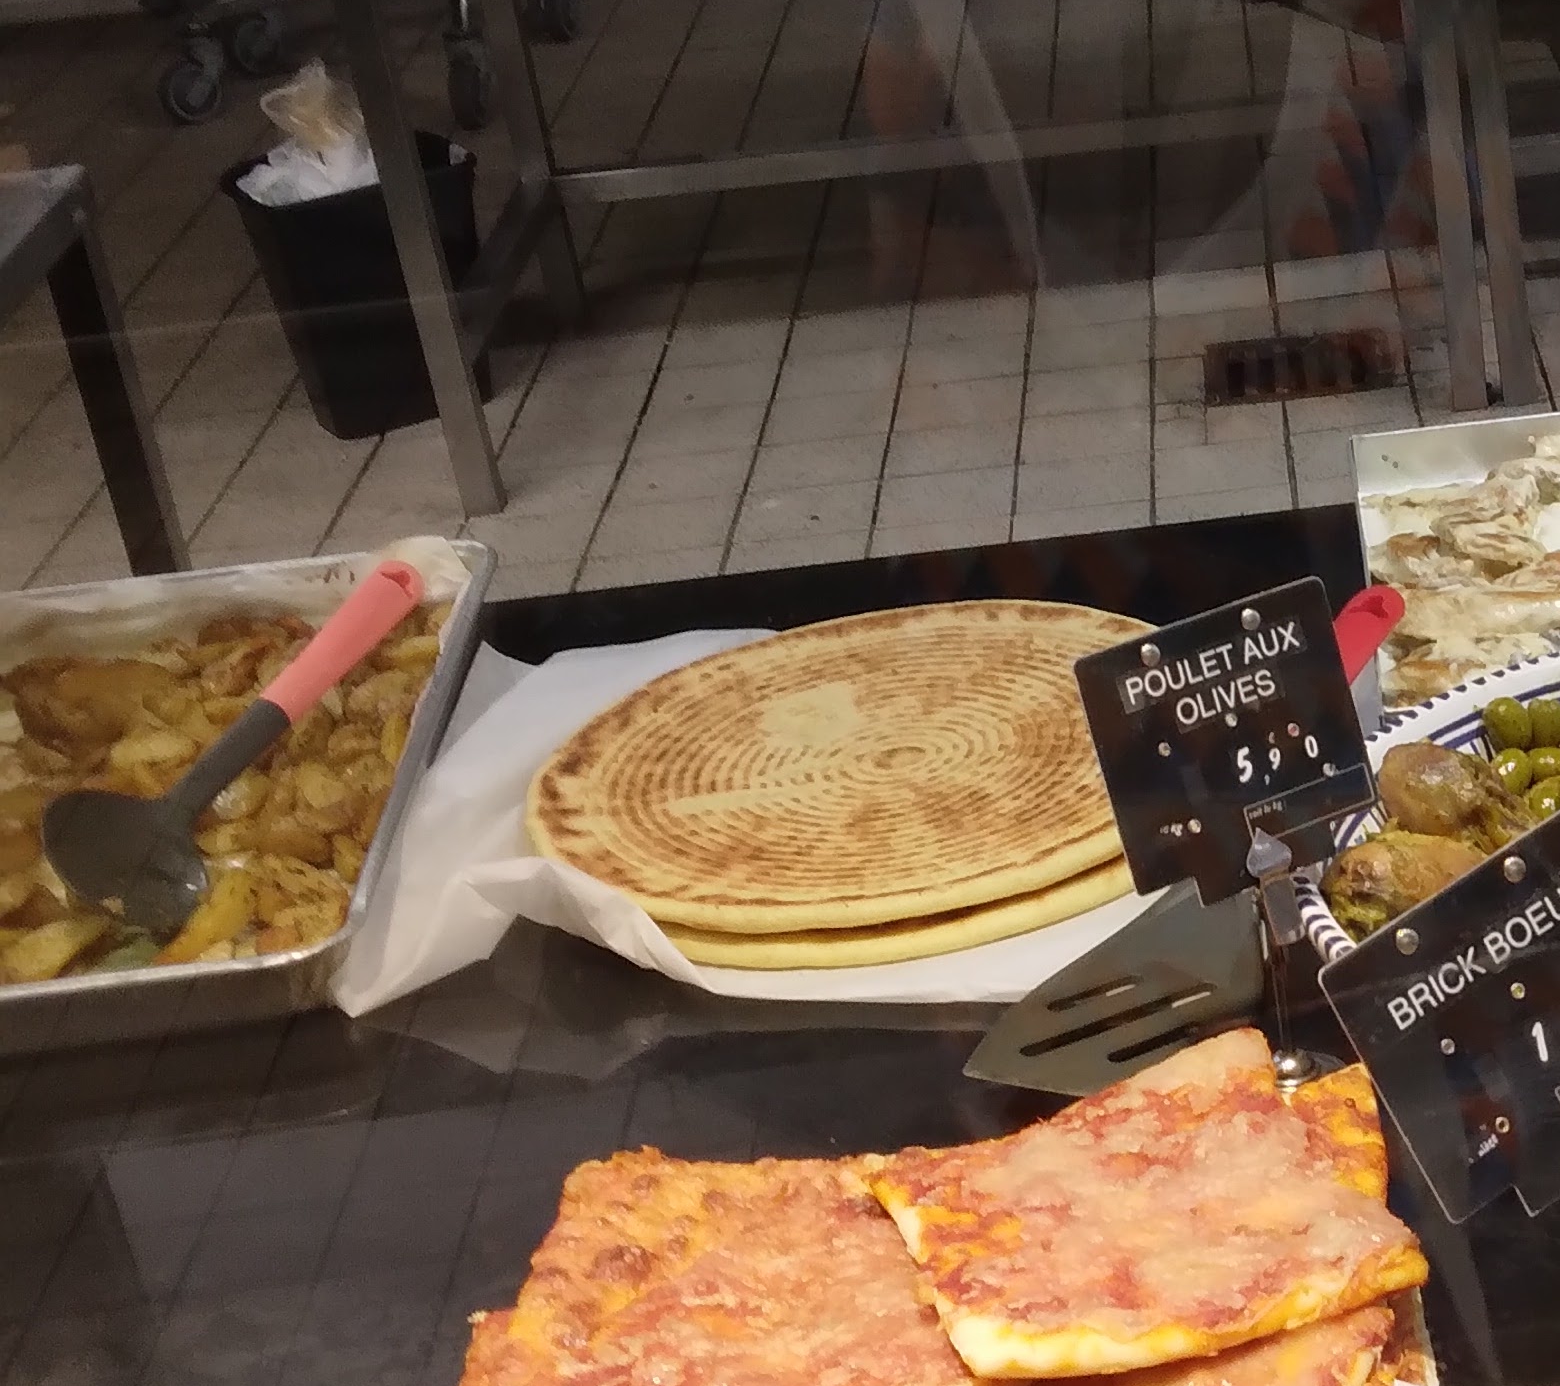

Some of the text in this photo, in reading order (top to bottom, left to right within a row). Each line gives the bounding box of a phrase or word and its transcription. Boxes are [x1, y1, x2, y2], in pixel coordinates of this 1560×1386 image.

[1125, 621, 1300, 705] POULET AUX
[1176, 669, 1276, 725] OLIVES
[1387, 945, 1486, 1030] BRICK
